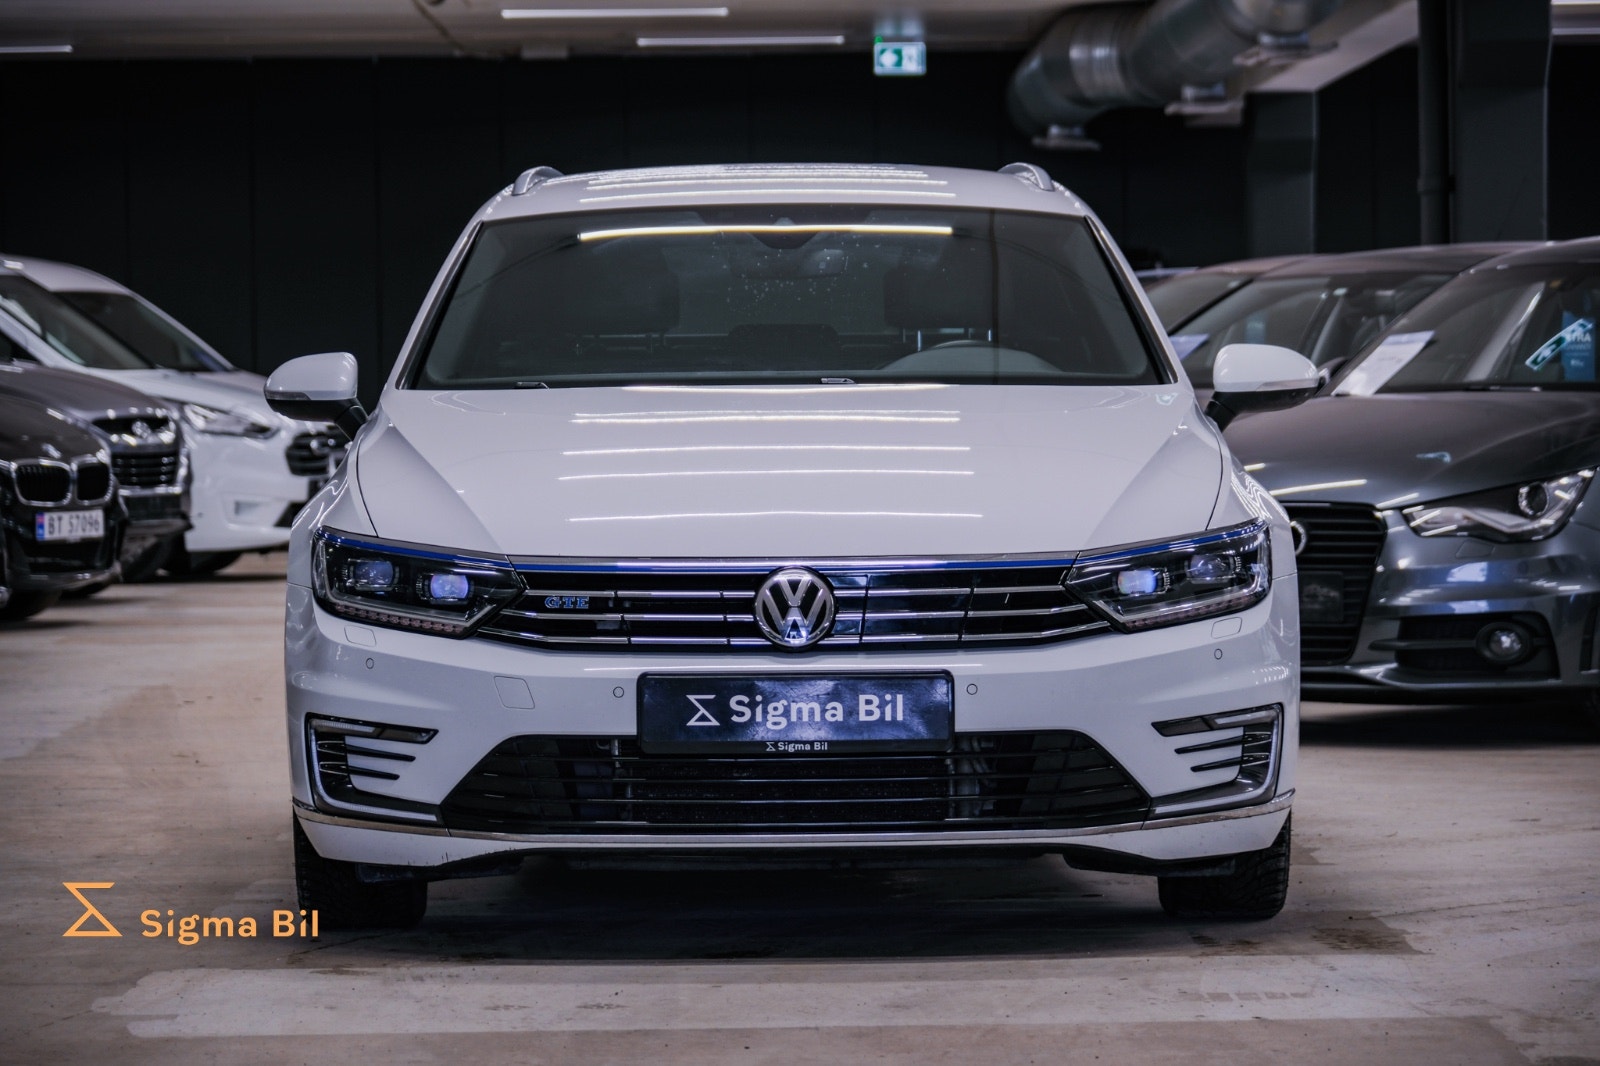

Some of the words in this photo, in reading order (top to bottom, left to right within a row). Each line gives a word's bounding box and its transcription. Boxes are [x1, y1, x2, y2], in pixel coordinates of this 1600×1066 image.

[48, 515, 63, 535] BT
[544, 595, 590, 609] GTE
[729, 694, 844, 730] Sigma
[858, 694, 904, 722] Bil
[777, 741, 811, 752] Sigma
[813, 741, 828, 751] Bil
